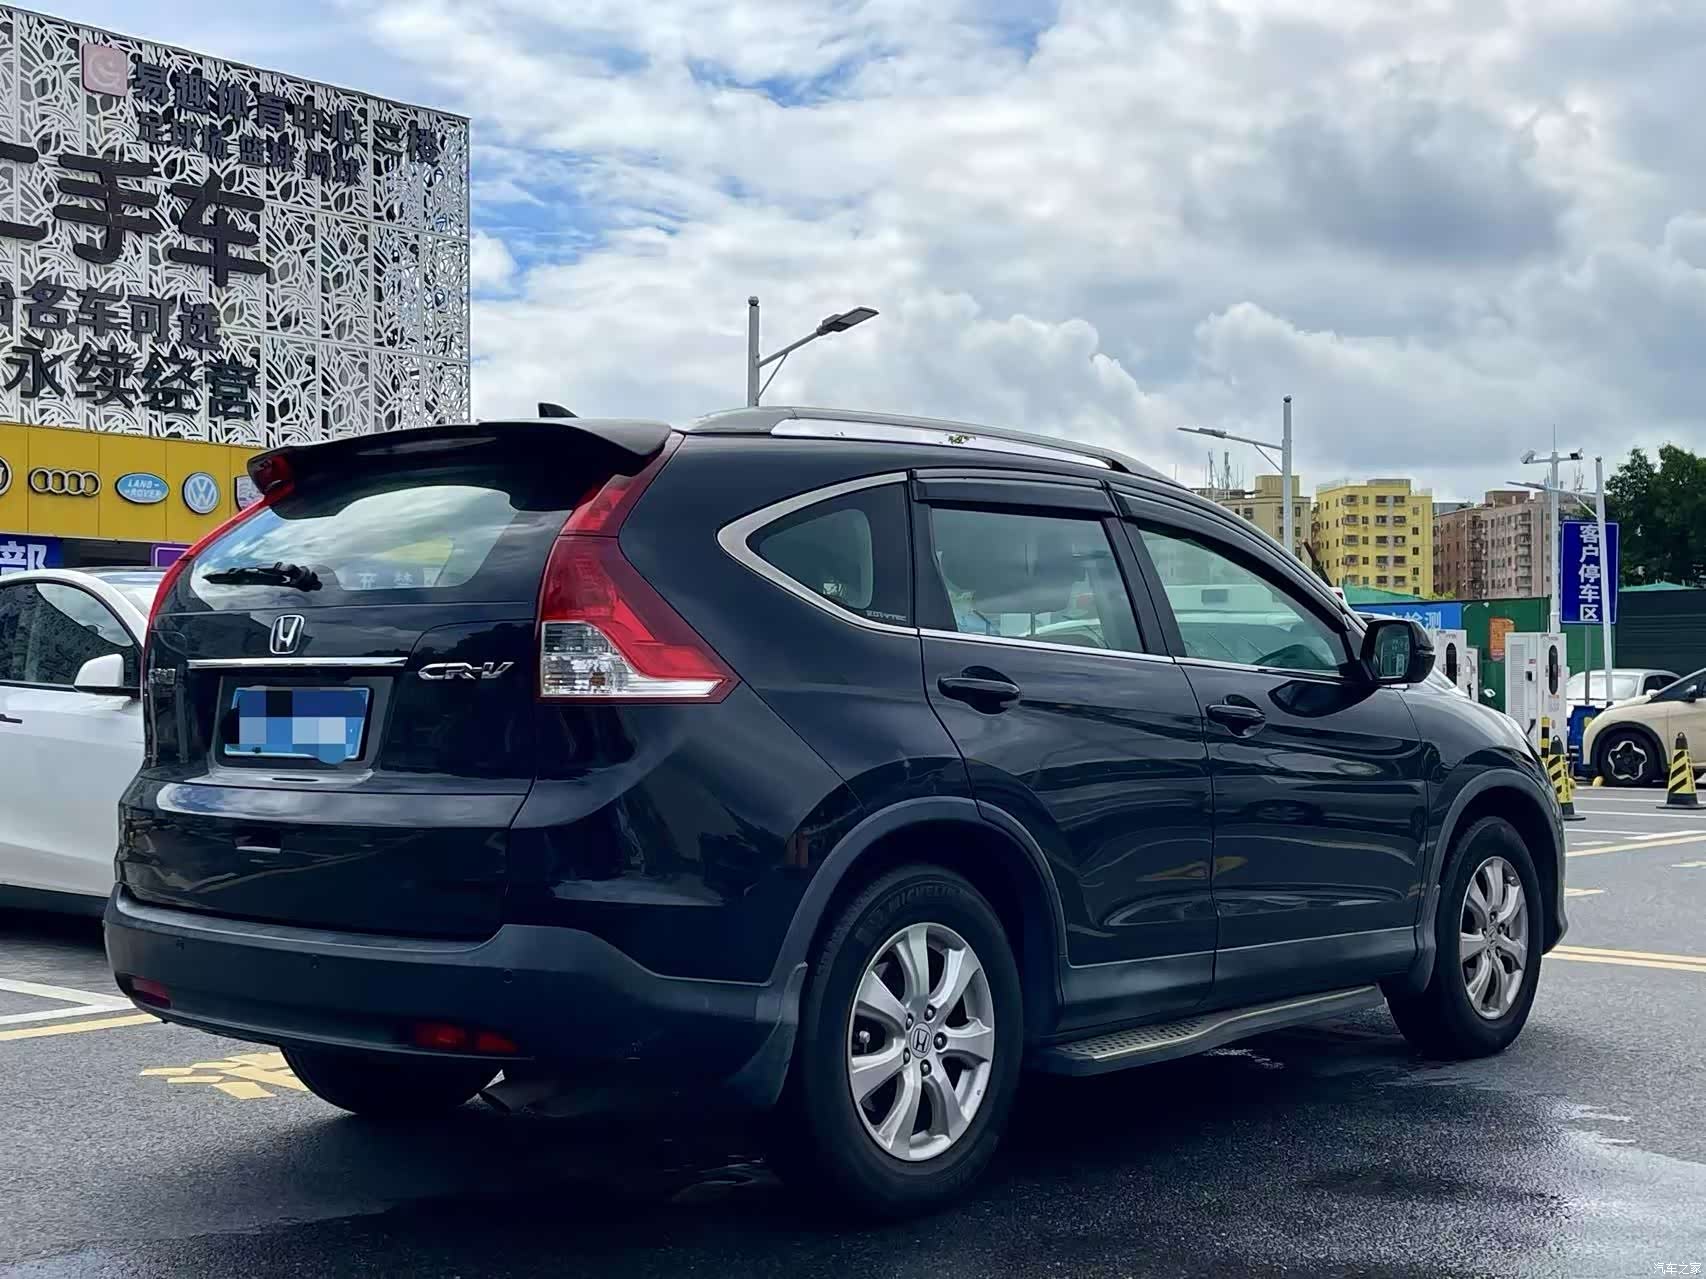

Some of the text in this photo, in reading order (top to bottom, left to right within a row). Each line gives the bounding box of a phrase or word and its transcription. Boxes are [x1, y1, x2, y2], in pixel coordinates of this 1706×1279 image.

[0, 280, 222, 351] 名车可选
[4, 333, 258, 421] 永续经营
[1578, 524, 1601, 622] 客户停车区
[417, 660, 515, 682] CR-V
